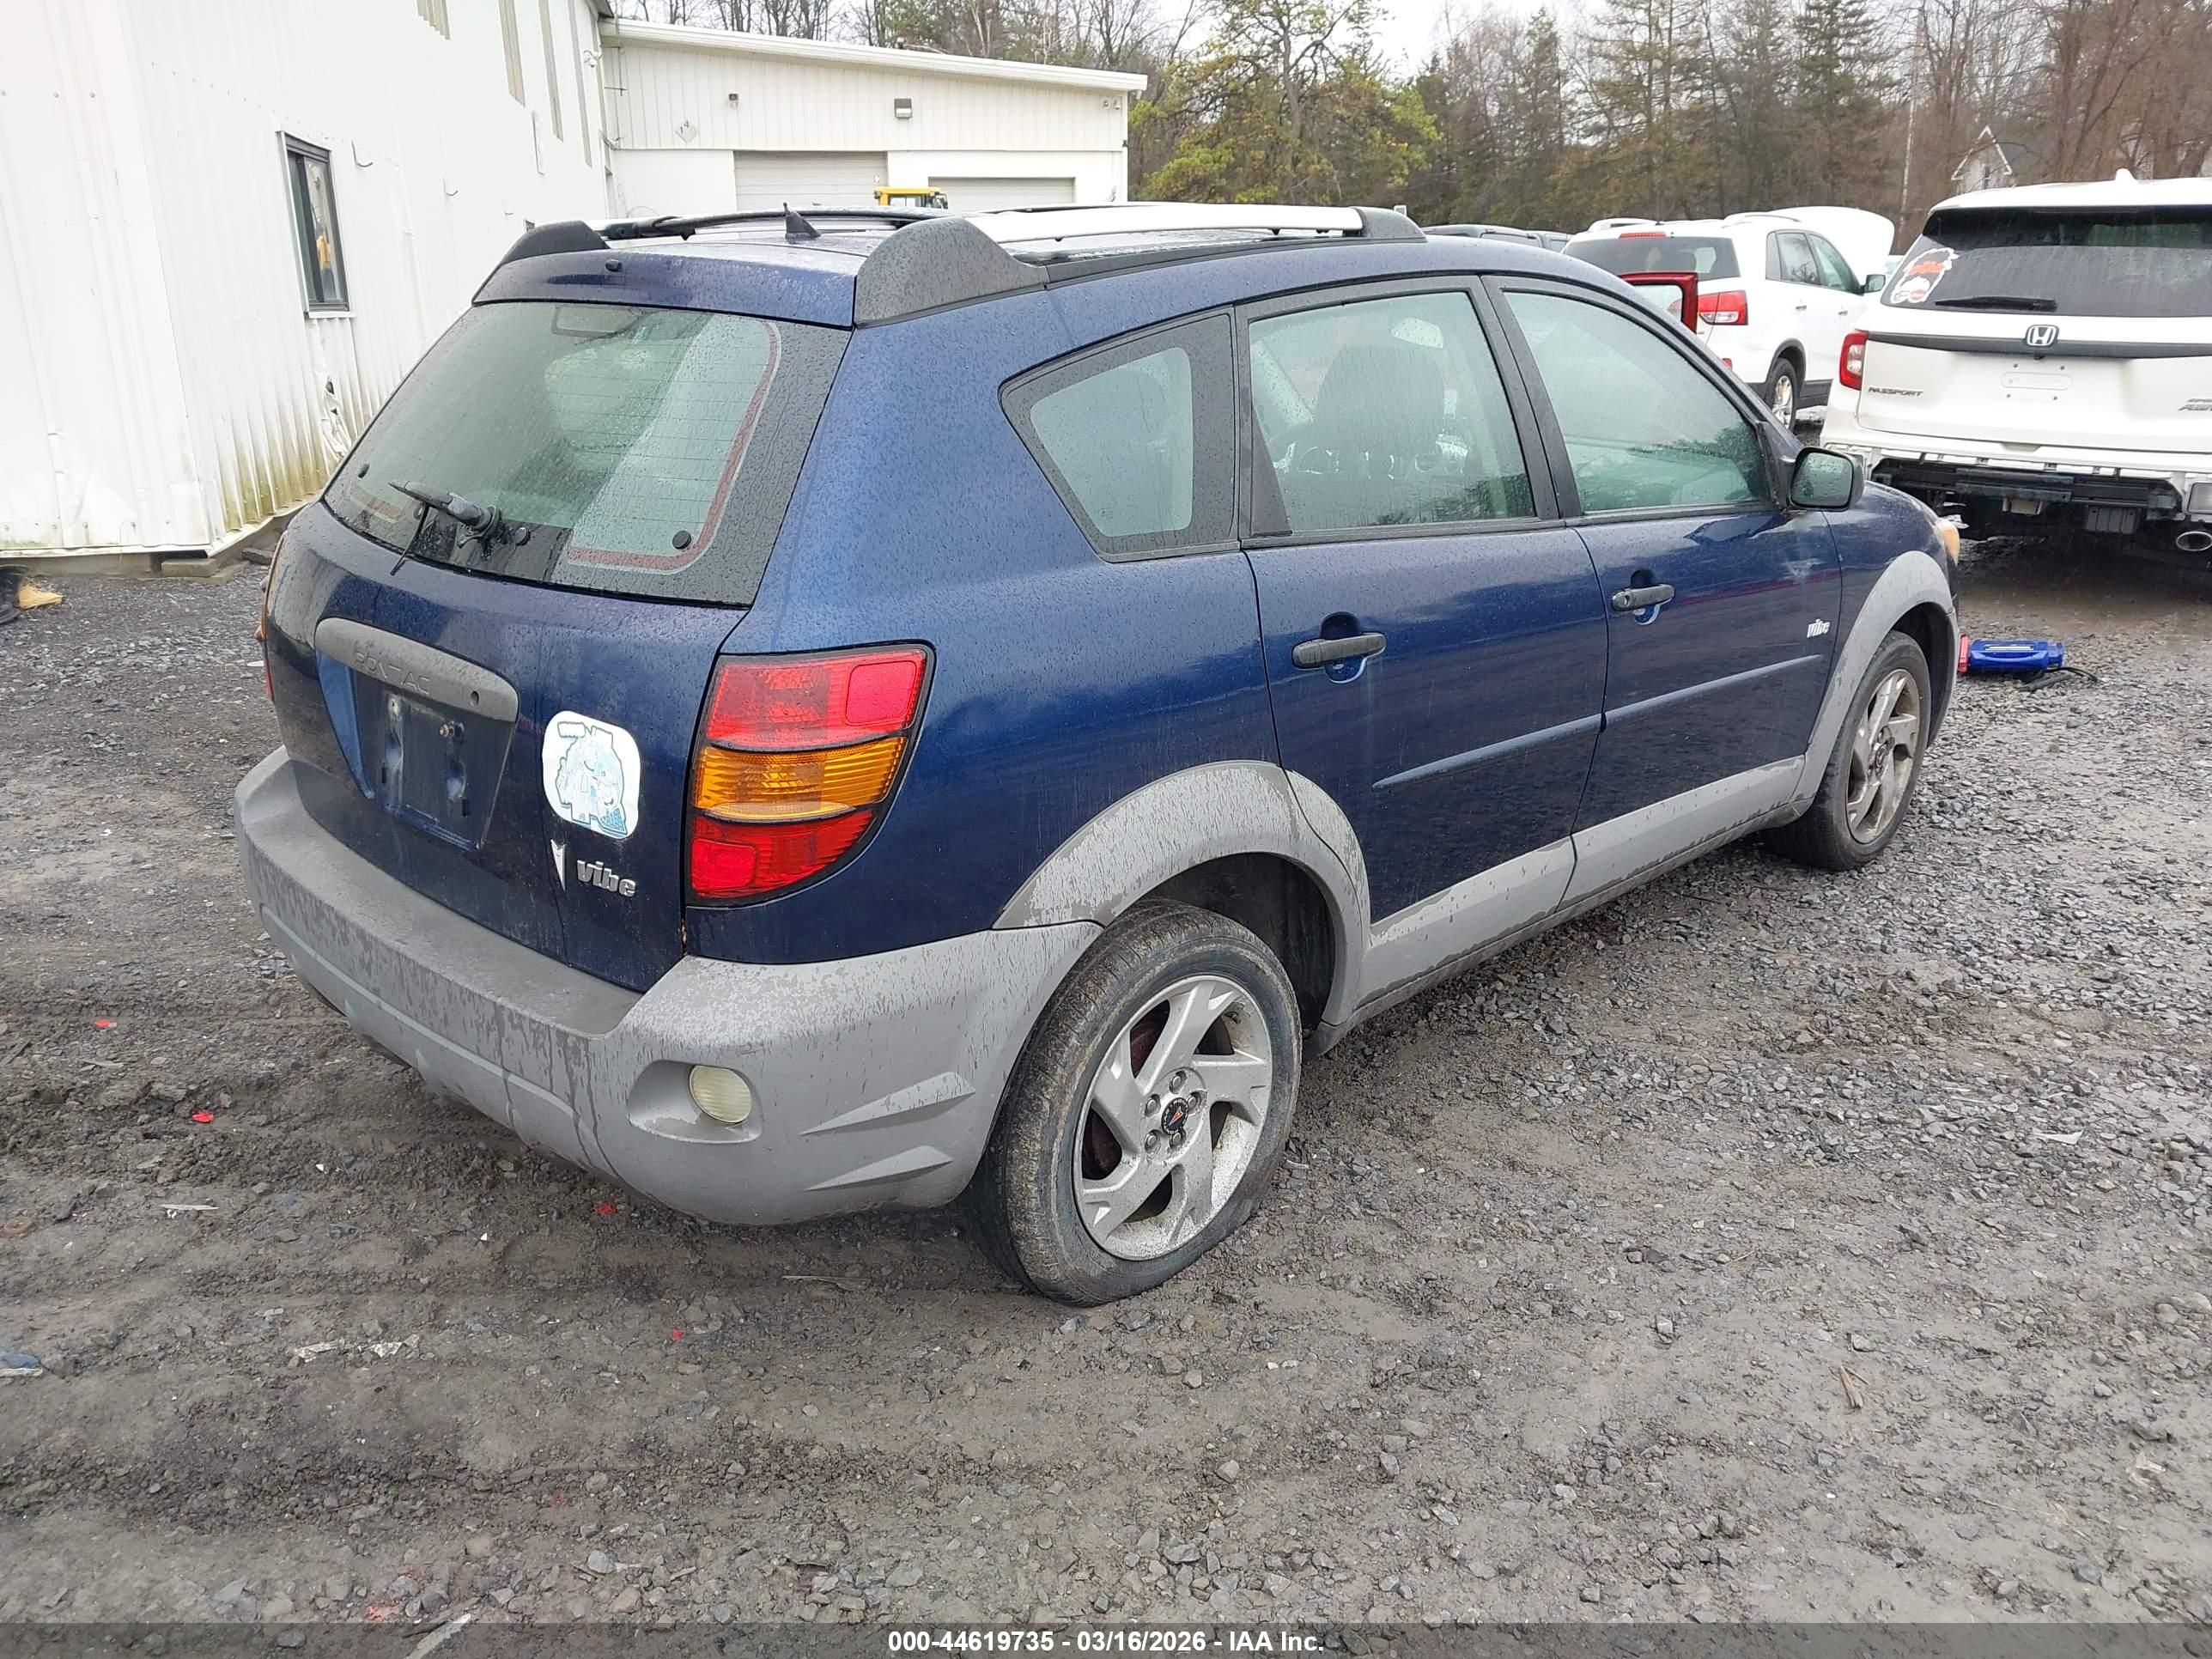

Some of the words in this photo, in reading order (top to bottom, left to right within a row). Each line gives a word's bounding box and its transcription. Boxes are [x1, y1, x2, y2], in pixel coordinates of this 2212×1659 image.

[1868, 386, 1924, 397] PASSPORT
[1806, 618, 1831, 638] vibe
[354, 651, 431, 695] PONTAC
[576, 860, 636, 897] vibe
